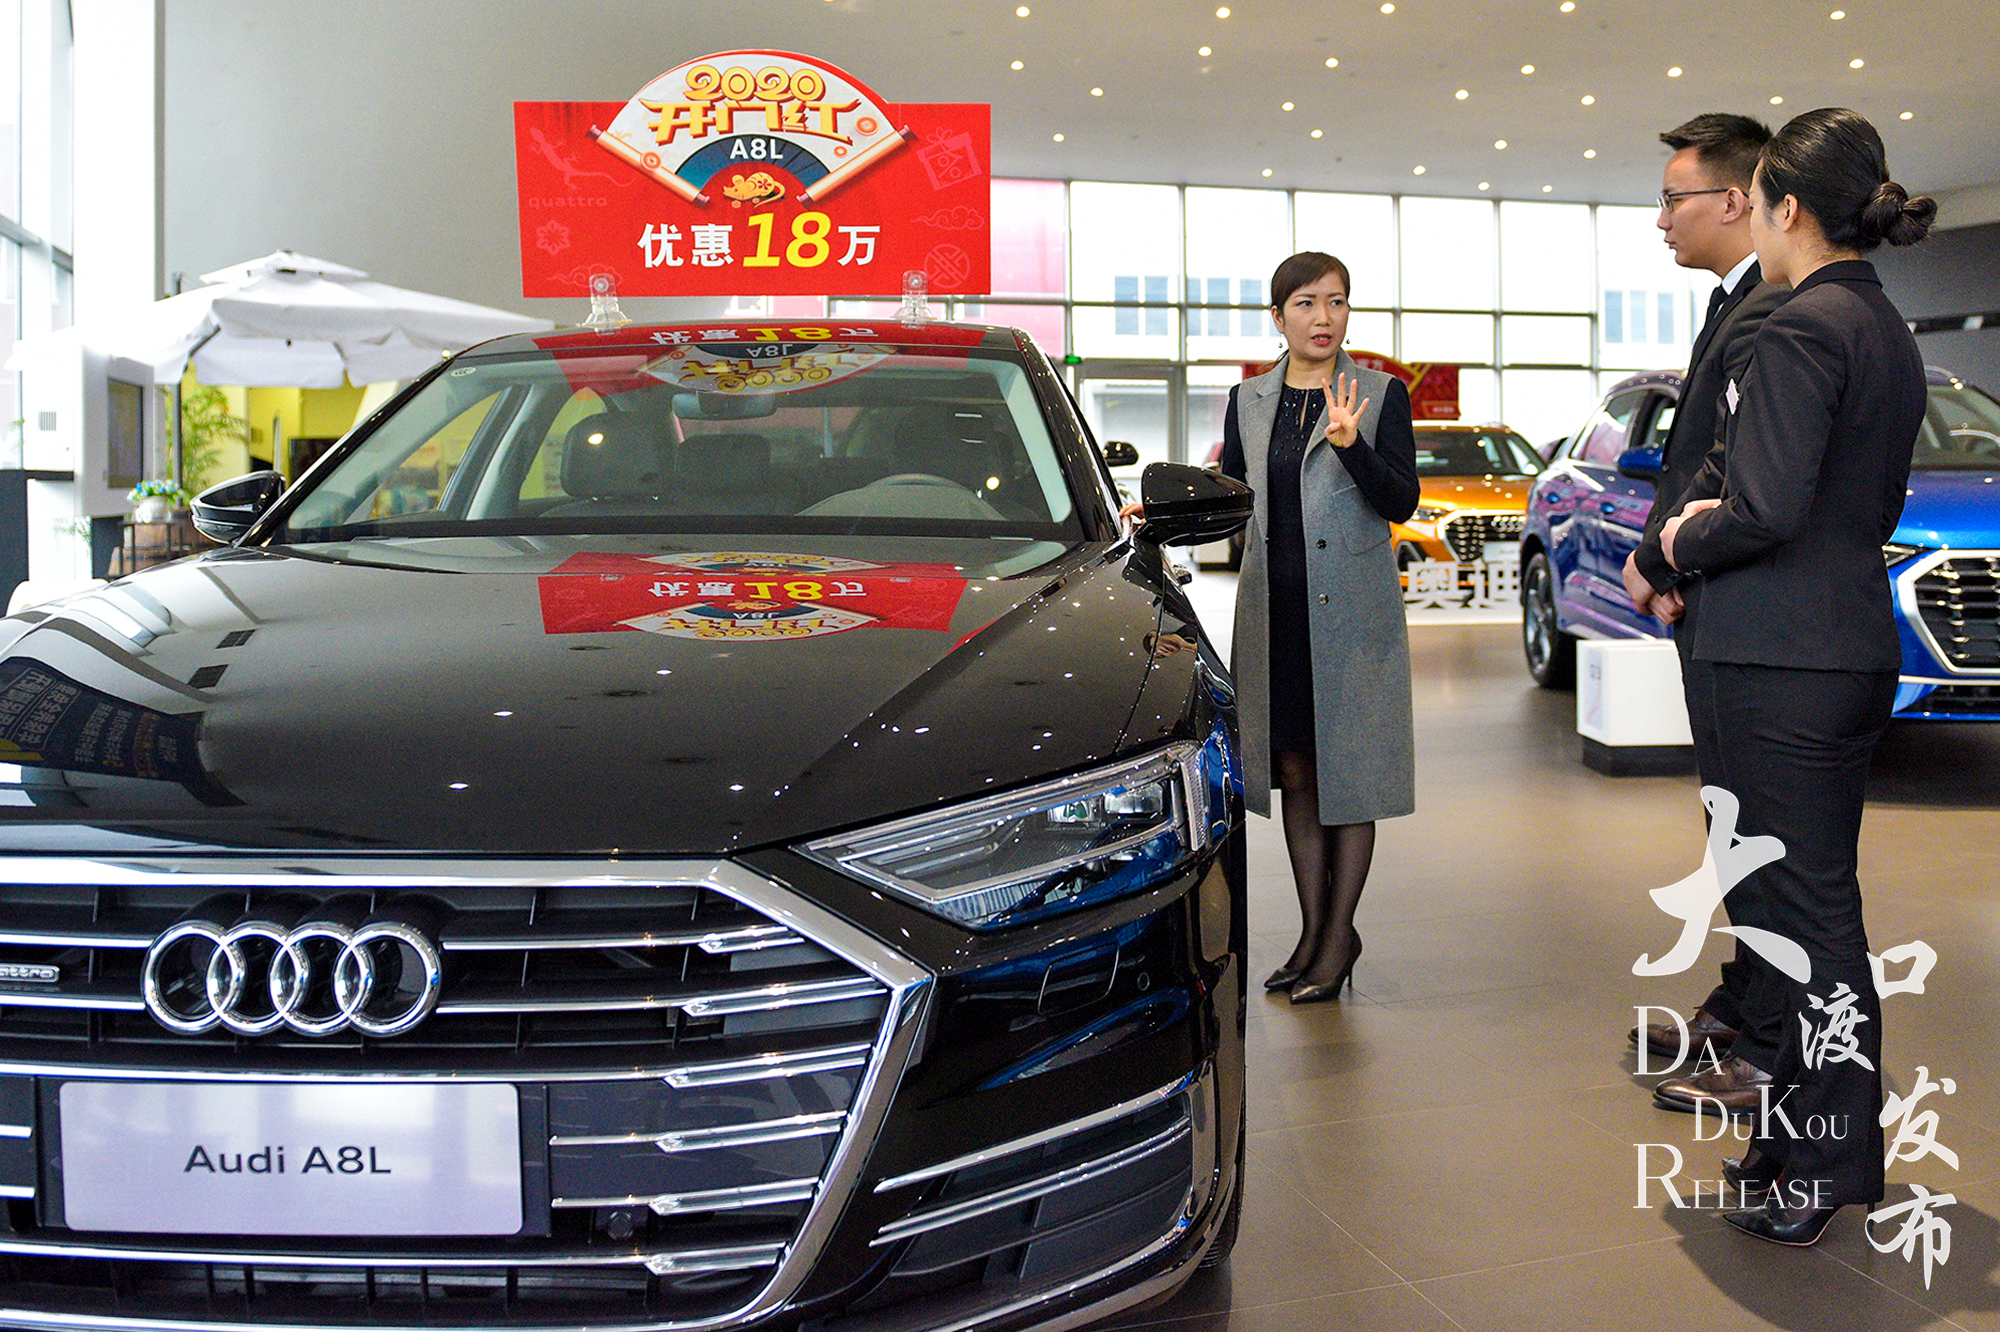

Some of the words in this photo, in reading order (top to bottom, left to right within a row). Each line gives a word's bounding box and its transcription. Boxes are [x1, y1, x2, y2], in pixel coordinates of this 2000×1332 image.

[684, 64, 827, 102] 2020
[638, 97, 862, 146] 开门红
[729, 138, 784, 161] A8L
[528, 195, 608, 210] quattro
[637, 211, 881, 269] 优惠18万
[184, 1145, 286, 1174] Audi
[301, 1146, 392, 1175] A8L
